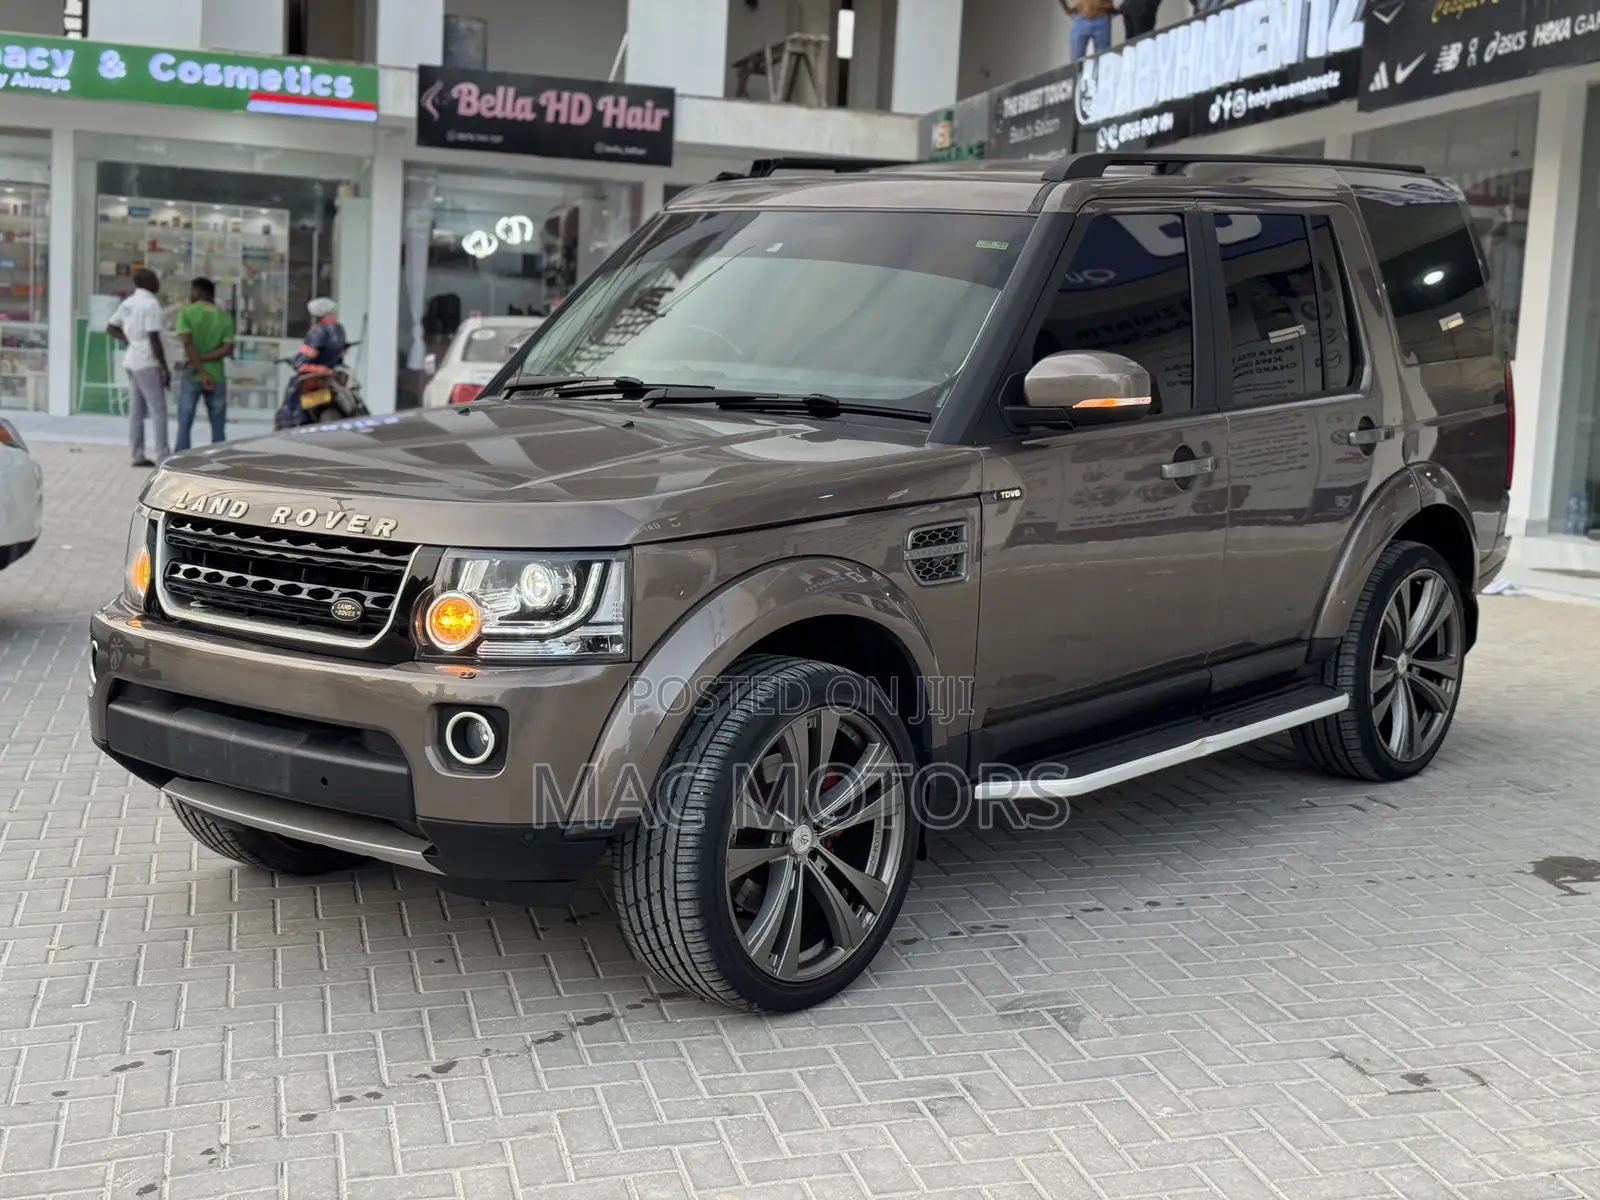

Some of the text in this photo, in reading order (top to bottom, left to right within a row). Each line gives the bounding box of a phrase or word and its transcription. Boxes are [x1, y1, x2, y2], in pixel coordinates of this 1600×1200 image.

[0, 44, 354, 98] acy & Cosmetics
[452, 82, 669, 132] Bella HD Hair
[173, 490, 398, 538] LAND ROVER
